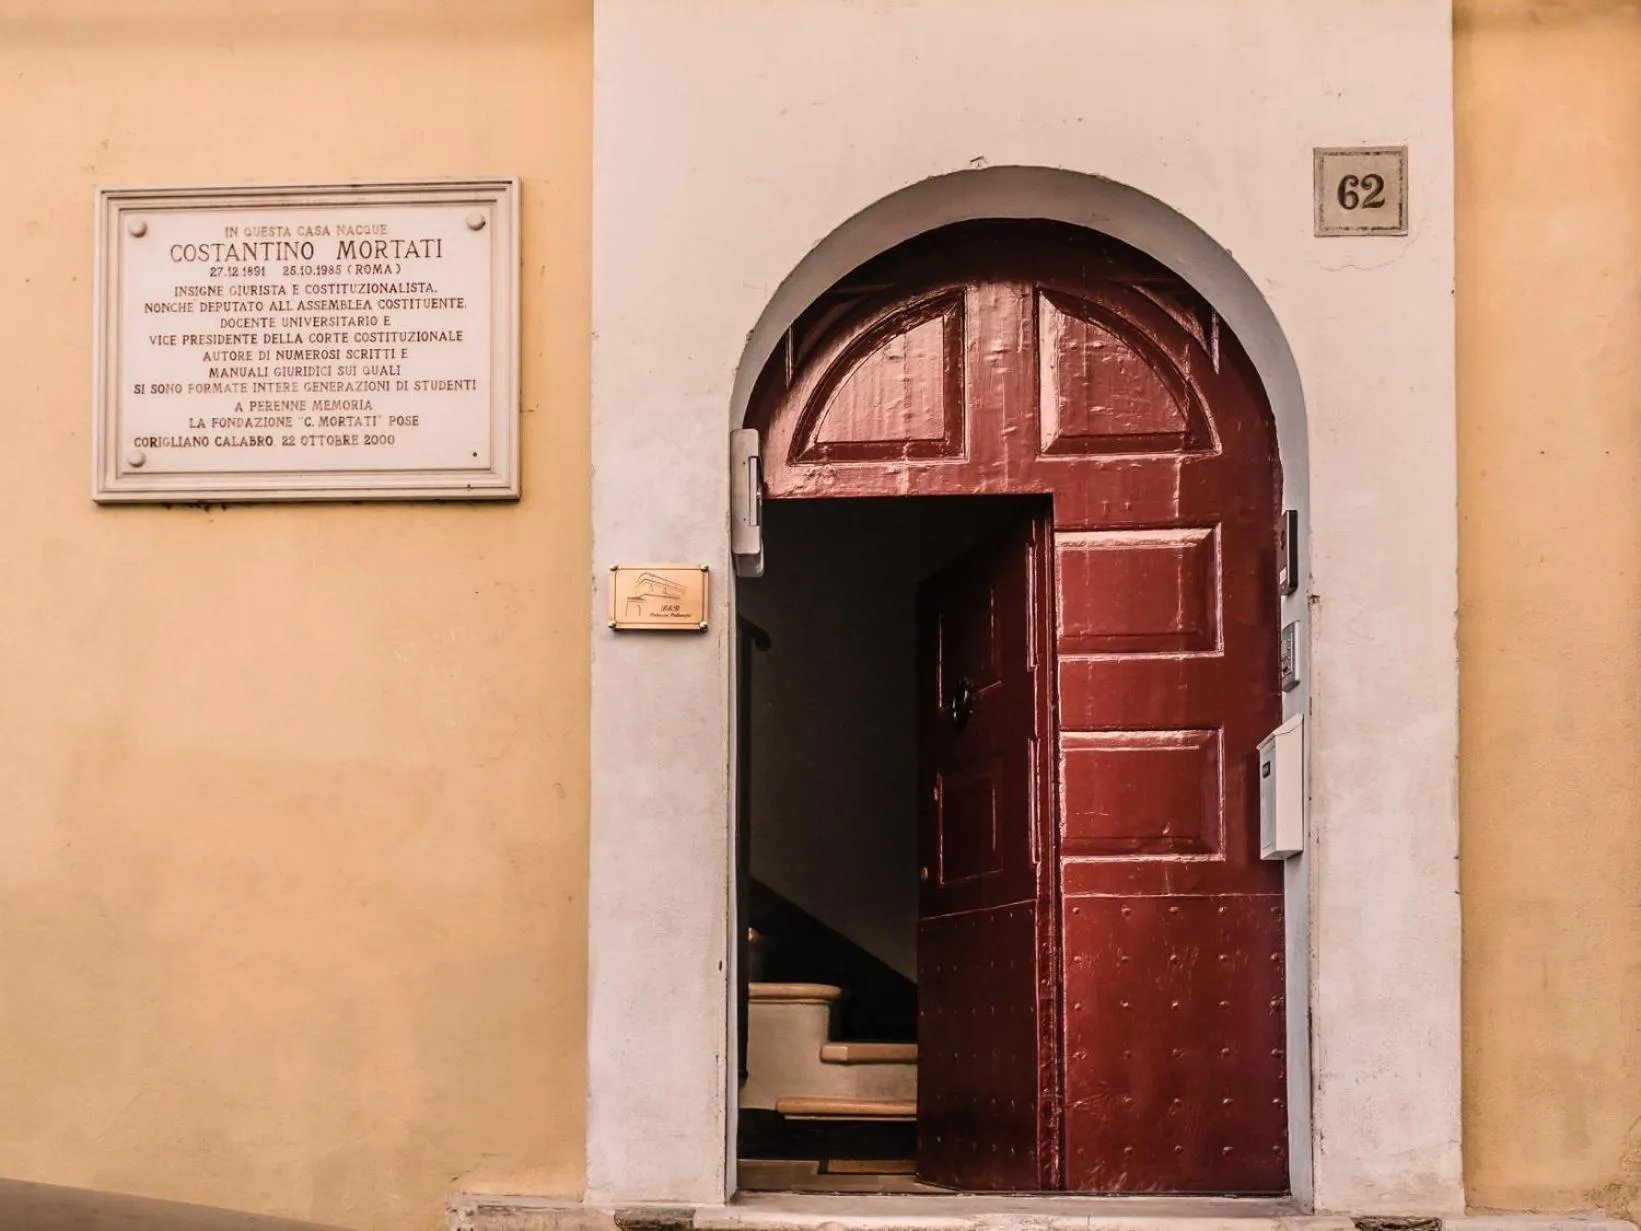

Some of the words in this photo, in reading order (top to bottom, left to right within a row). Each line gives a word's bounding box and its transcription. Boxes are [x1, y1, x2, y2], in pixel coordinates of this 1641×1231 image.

[1337, 173, 1386, 210] 62
[225, 226, 239, 238] IN
[244, 226, 292, 238] QUESTA
[296, 226, 331, 237] CASA
[337, 224, 388, 237] NACQUE
[170, 241, 315, 263] COSTANTINO
[335, 238, 443, 261] MORTATI
[282, 265, 342, 276] 25.10.1985
[174, 285, 224, 297] INSIGNE
[229, 284, 286, 296] GIURISTA
[292, 284, 300, 295] E
[144, 301, 193, 313] NONCHE
[200, 301, 264, 312] DEPUTATO
[297, 299, 373, 311] ASSEMBLEA
[220, 317, 276, 329] DOCENTE
[282, 315, 378, 327] UNIVERSITARIO
[383, 315, 391, 327] E
[149, 334, 176, 346] VICE
[182, 333, 258, 346] PRESIDENTE
[263, 333, 303, 344] DELLA
[308, 332, 349, 344] CORTE
[354, 330, 463, 343] COSTITUZIONALE
[202, 350, 253, 362] AUTORE
[258, 350, 270, 361] DI
[275, 349, 340, 361] NUMEROSI
[346, 348, 396, 360] SCRITTI
[401, 348, 409, 359] E
[208, 366, 268, 379] MANUALI
[273, 366, 332, 377] GIURIDICI
[337, 365, 357, 377] SUI
[362, 364, 401, 376] QUALI
[133, 383, 145, 395] SI
[150, 383, 183, 394] SONO
[187, 382, 248, 394] FORMATE
[253, 382, 299, 393] INTERE
[303, 380, 390, 393] GENERAZIONI
[396, 380, 408, 391] DI
[413, 378, 476, 391] STUDENTI
[234, 400, 243, 413] A
[249, 400, 306, 412] PERENNE
[312, 399, 373, 411] MEMORIA
[189, 417, 206, 429] LA
[211, 416, 293, 428] FONDAZIONE
[388, 414, 420, 427] POSE
[134, 436, 210, 448] CORIGLIANO
[214, 435, 274, 447] CALABRO
[281, 435, 296, 446] 22
[300, 434, 359, 446] OTTOBRE
[364, 433, 396, 445] 2000
